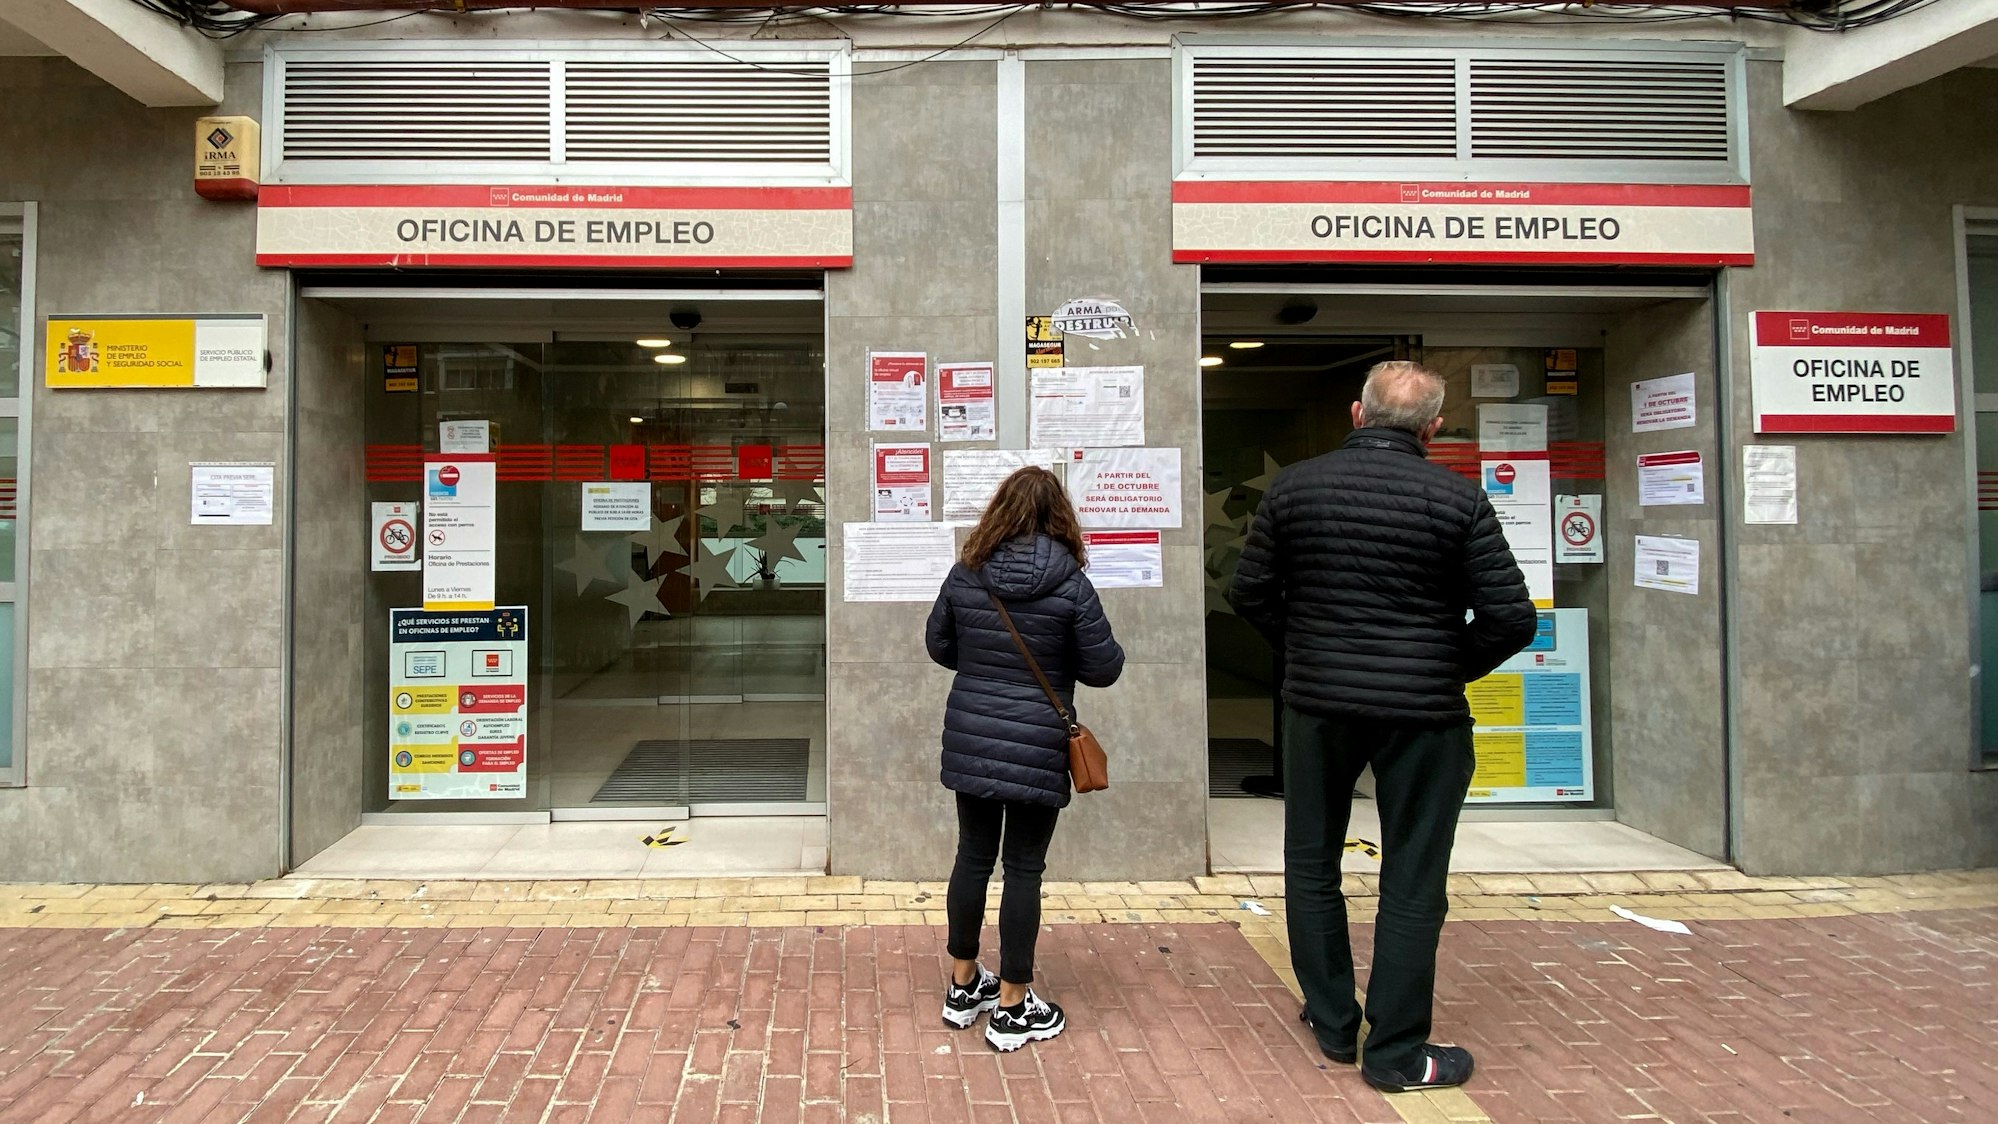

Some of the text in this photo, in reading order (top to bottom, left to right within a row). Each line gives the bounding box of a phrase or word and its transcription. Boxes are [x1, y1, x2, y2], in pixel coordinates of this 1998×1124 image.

[512, 193, 623, 202] Comunidad de Madrid
[1422, 189, 1530, 199] Comunidad de Madrid
[397, 219, 715, 244] OFICINA DE EMPLEO
[1311, 215, 1620, 240] OFICINA DE EMPLEO
[1067, 306, 1102, 315] ARMA
[1811, 325, 1919, 336] Comunidad de Madrid
[228, 347, 253, 355] PÚBLICO
[1793, 359, 1920, 378] OFICINA DE
[1812, 384, 1905, 402] EMPLEO
[1657, 397, 1688, 406] OCTUBRE
[398, 618, 415, 627] ¿QUÉ
[416, 617, 450, 625] SERVICIOS
[413, 666, 437, 674] SEPE
